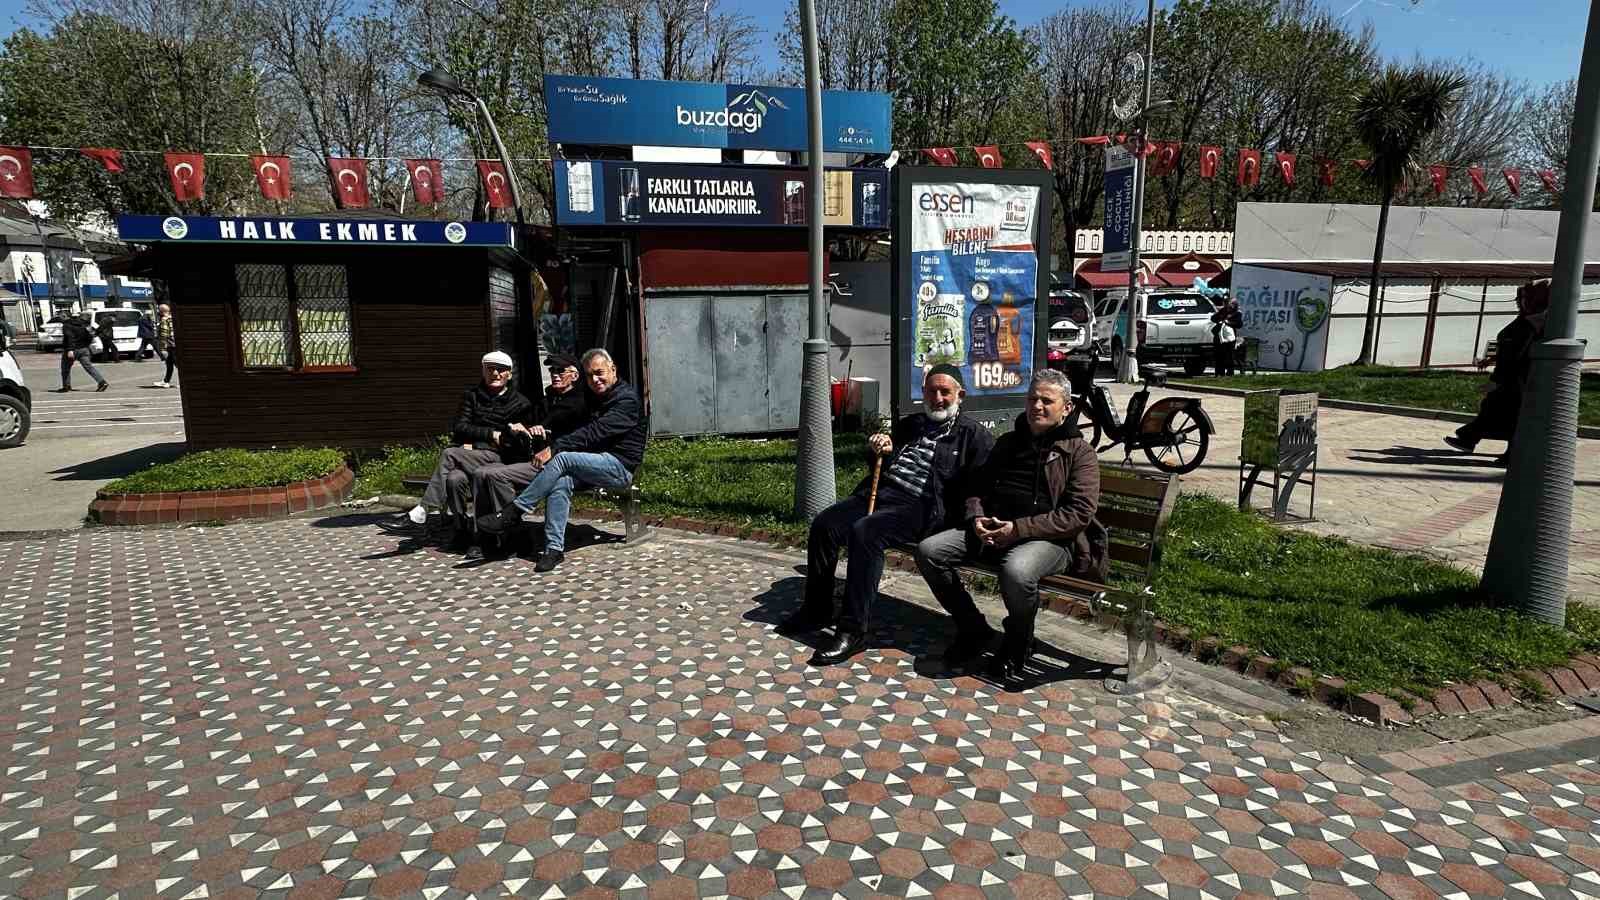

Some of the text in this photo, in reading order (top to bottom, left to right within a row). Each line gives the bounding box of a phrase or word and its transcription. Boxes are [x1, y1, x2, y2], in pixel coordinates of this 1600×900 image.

[586, 84, 599, 94] Su
[676, 106, 763, 133] buzdağı
[647, 178, 755, 196] FARKLI TATLARLA
[648, 197, 762, 215] KANATLANDIRIIIR.
[919, 191, 974, 214] essen
[1114, 190, 1122, 233] ÇOCUK
[219, 220, 417, 241] HALK EKMEK
[1243, 309, 1291, 324] AFTASI
